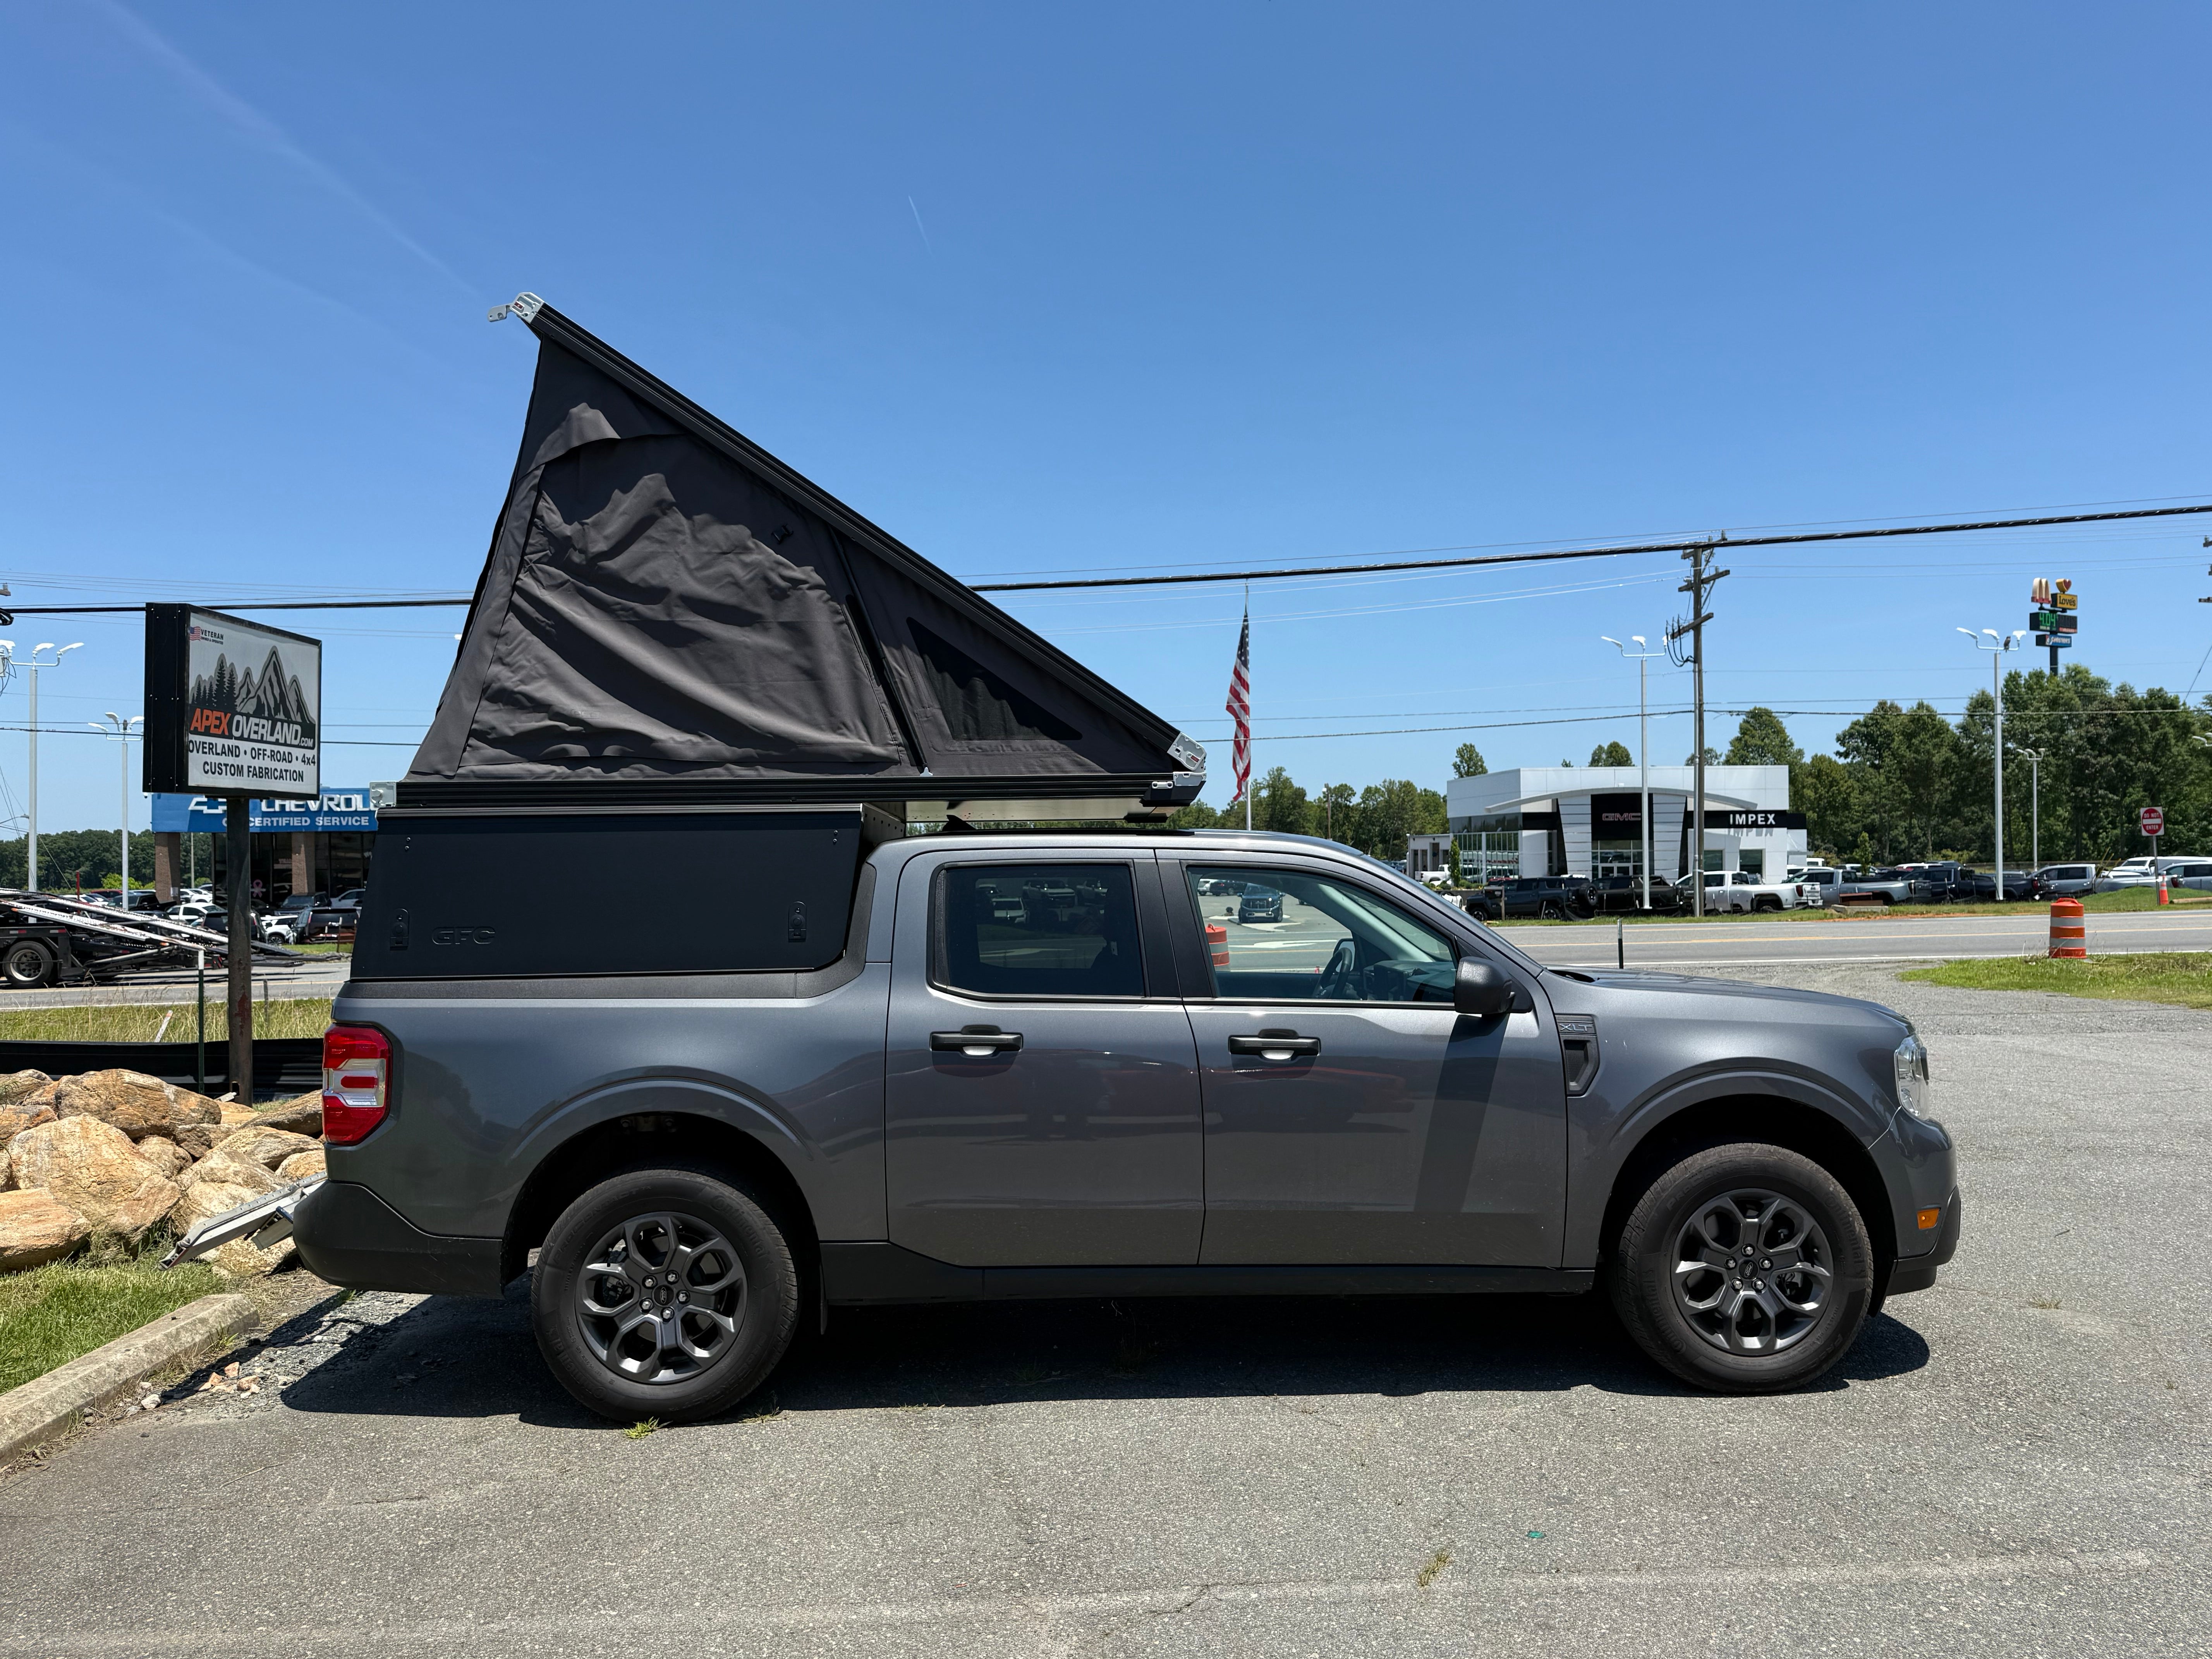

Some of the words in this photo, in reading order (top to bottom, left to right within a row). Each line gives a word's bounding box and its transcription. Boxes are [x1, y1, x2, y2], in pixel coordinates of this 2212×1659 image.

[201, 629, 223, 640] VETERAN
[191, 708, 231, 735] APEX
[189, 740, 240, 758] OVERLAND
[251, 747, 293, 764] OFF-ROAD
[203, 761, 244, 777] CUSTOM
[247, 765, 304, 782] FABRICATION
[261, 794, 377, 812] CHEVROL
[249, 817, 310, 826] CERTIFIED
[315, 816, 369, 826] SERVICE
[1602, 813, 1641, 821] GMC
[1730, 814, 1776, 825] IMPEX
[432, 927, 495, 945] GFC
